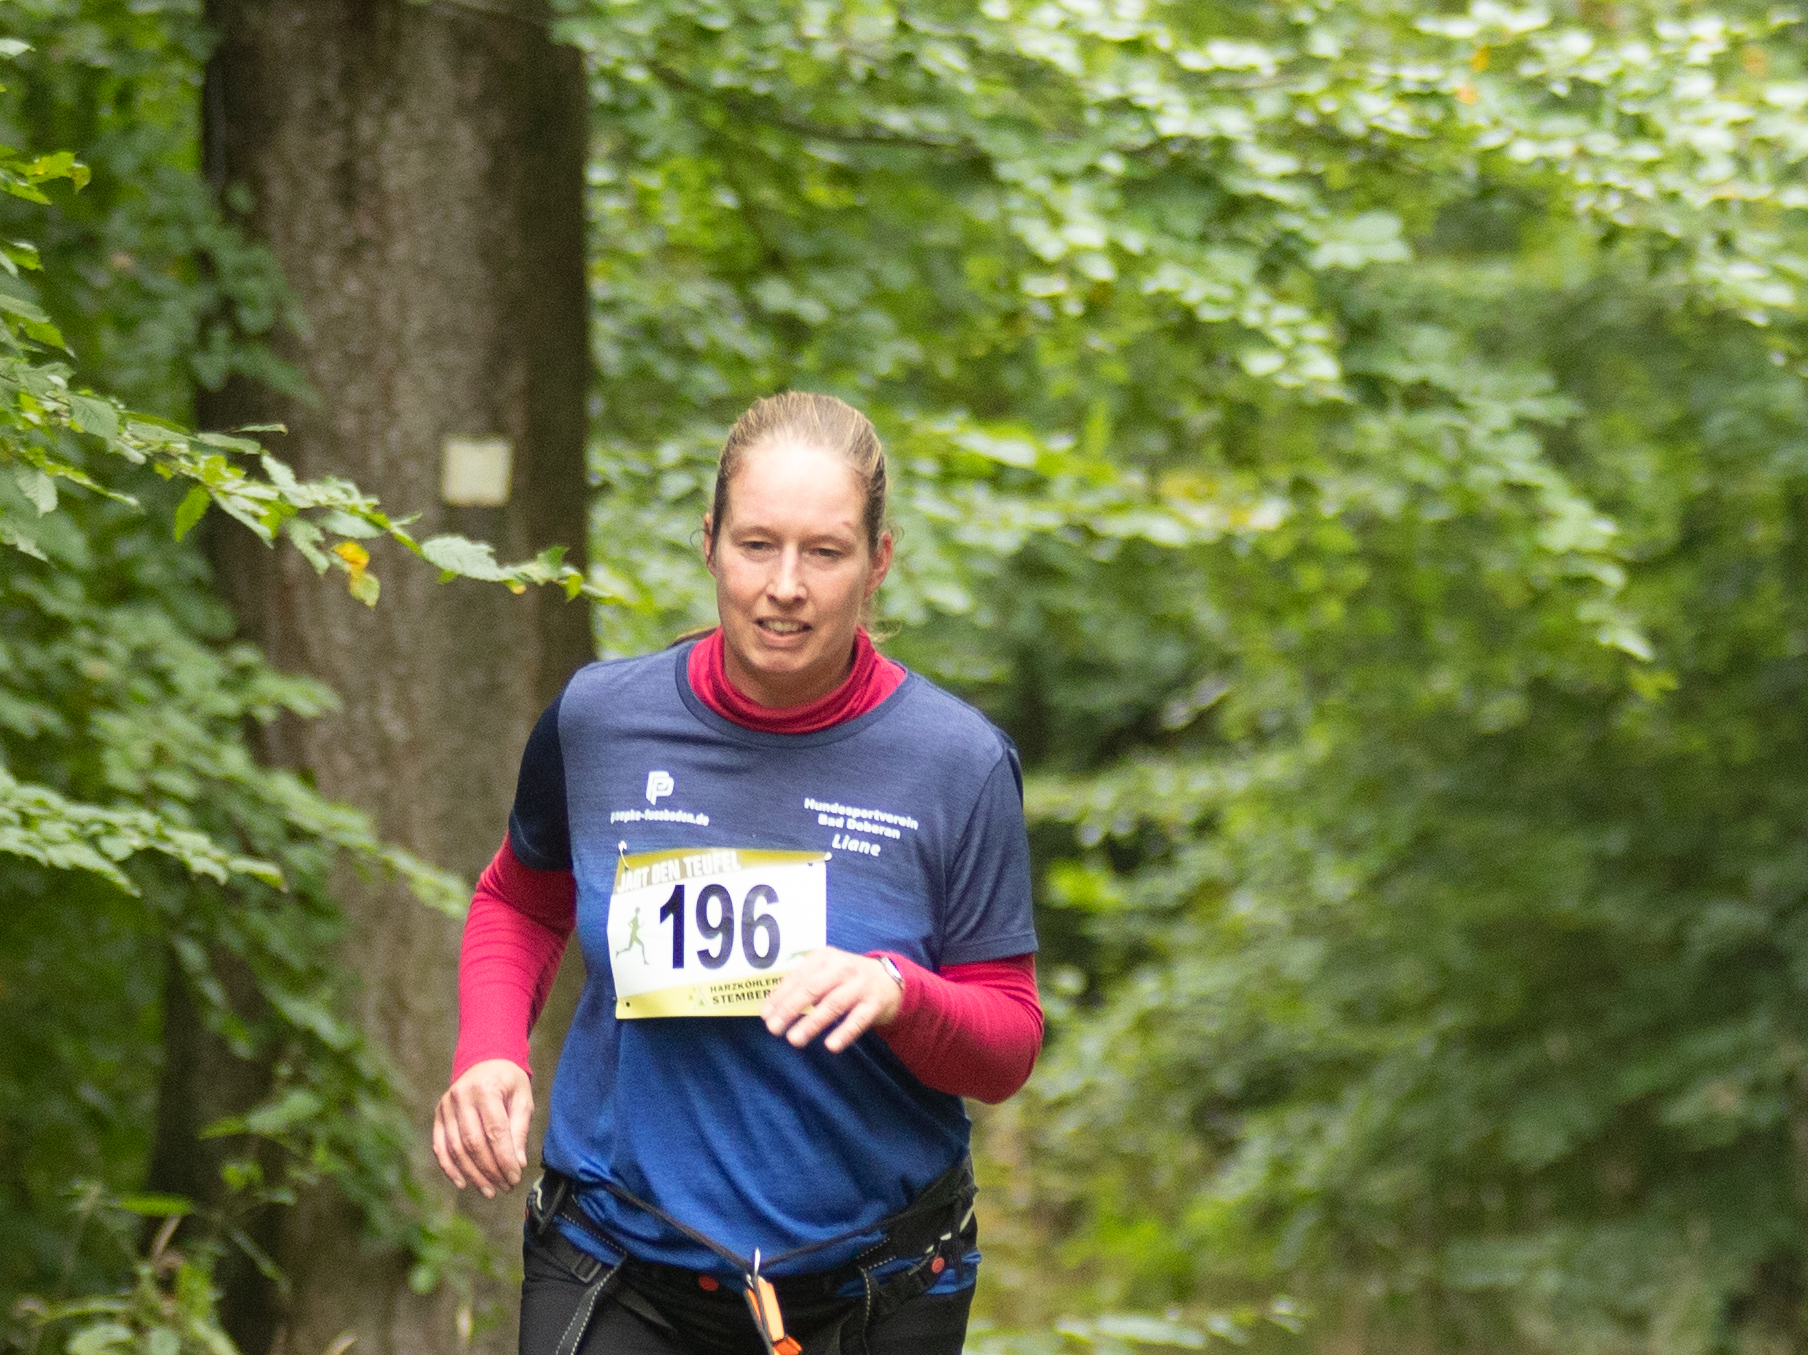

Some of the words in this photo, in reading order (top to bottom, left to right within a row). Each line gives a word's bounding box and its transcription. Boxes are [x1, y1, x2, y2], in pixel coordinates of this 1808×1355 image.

[804, 797, 919, 830] Hundesportverein
[818, 813, 844, 829] Bad
[846, 817, 901, 840] Doberan
[832, 833, 881, 857] Liane
[616, 867, 650, 894] JAGT
[651, 859, 681, 885] DEN
[683, 850, 741, 878] TEUFEL
[659, 883, 781, 970] 196
[713, 989, 772, 1005] STEMBER
